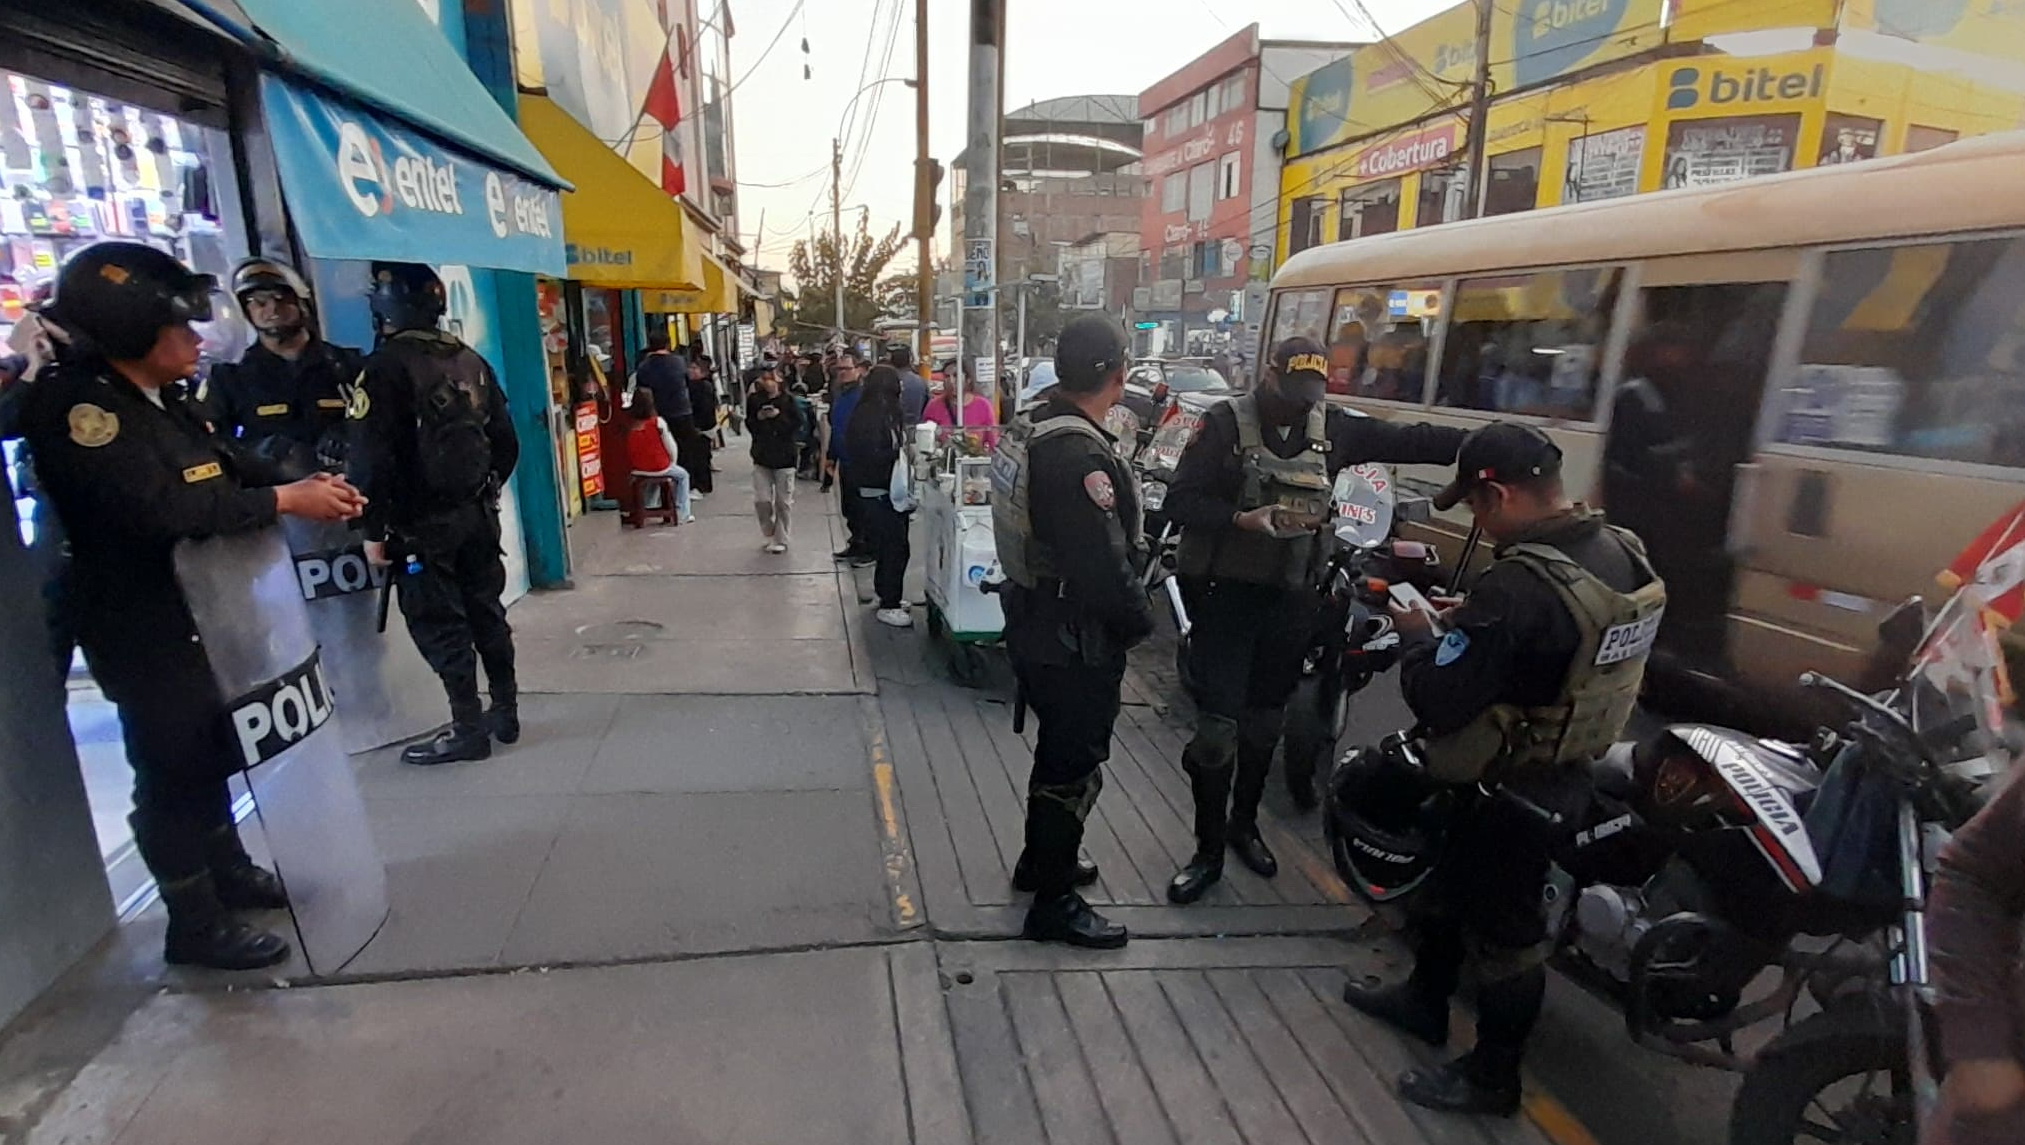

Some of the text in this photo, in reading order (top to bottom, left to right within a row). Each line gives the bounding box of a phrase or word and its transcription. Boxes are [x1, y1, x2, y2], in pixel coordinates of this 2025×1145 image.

[1710, 63, 1824, 104] bitel
[394, 155, 463, 214] entel
[514, 193, 552, 239] entel
[231, 660, 335, 767] POLI
